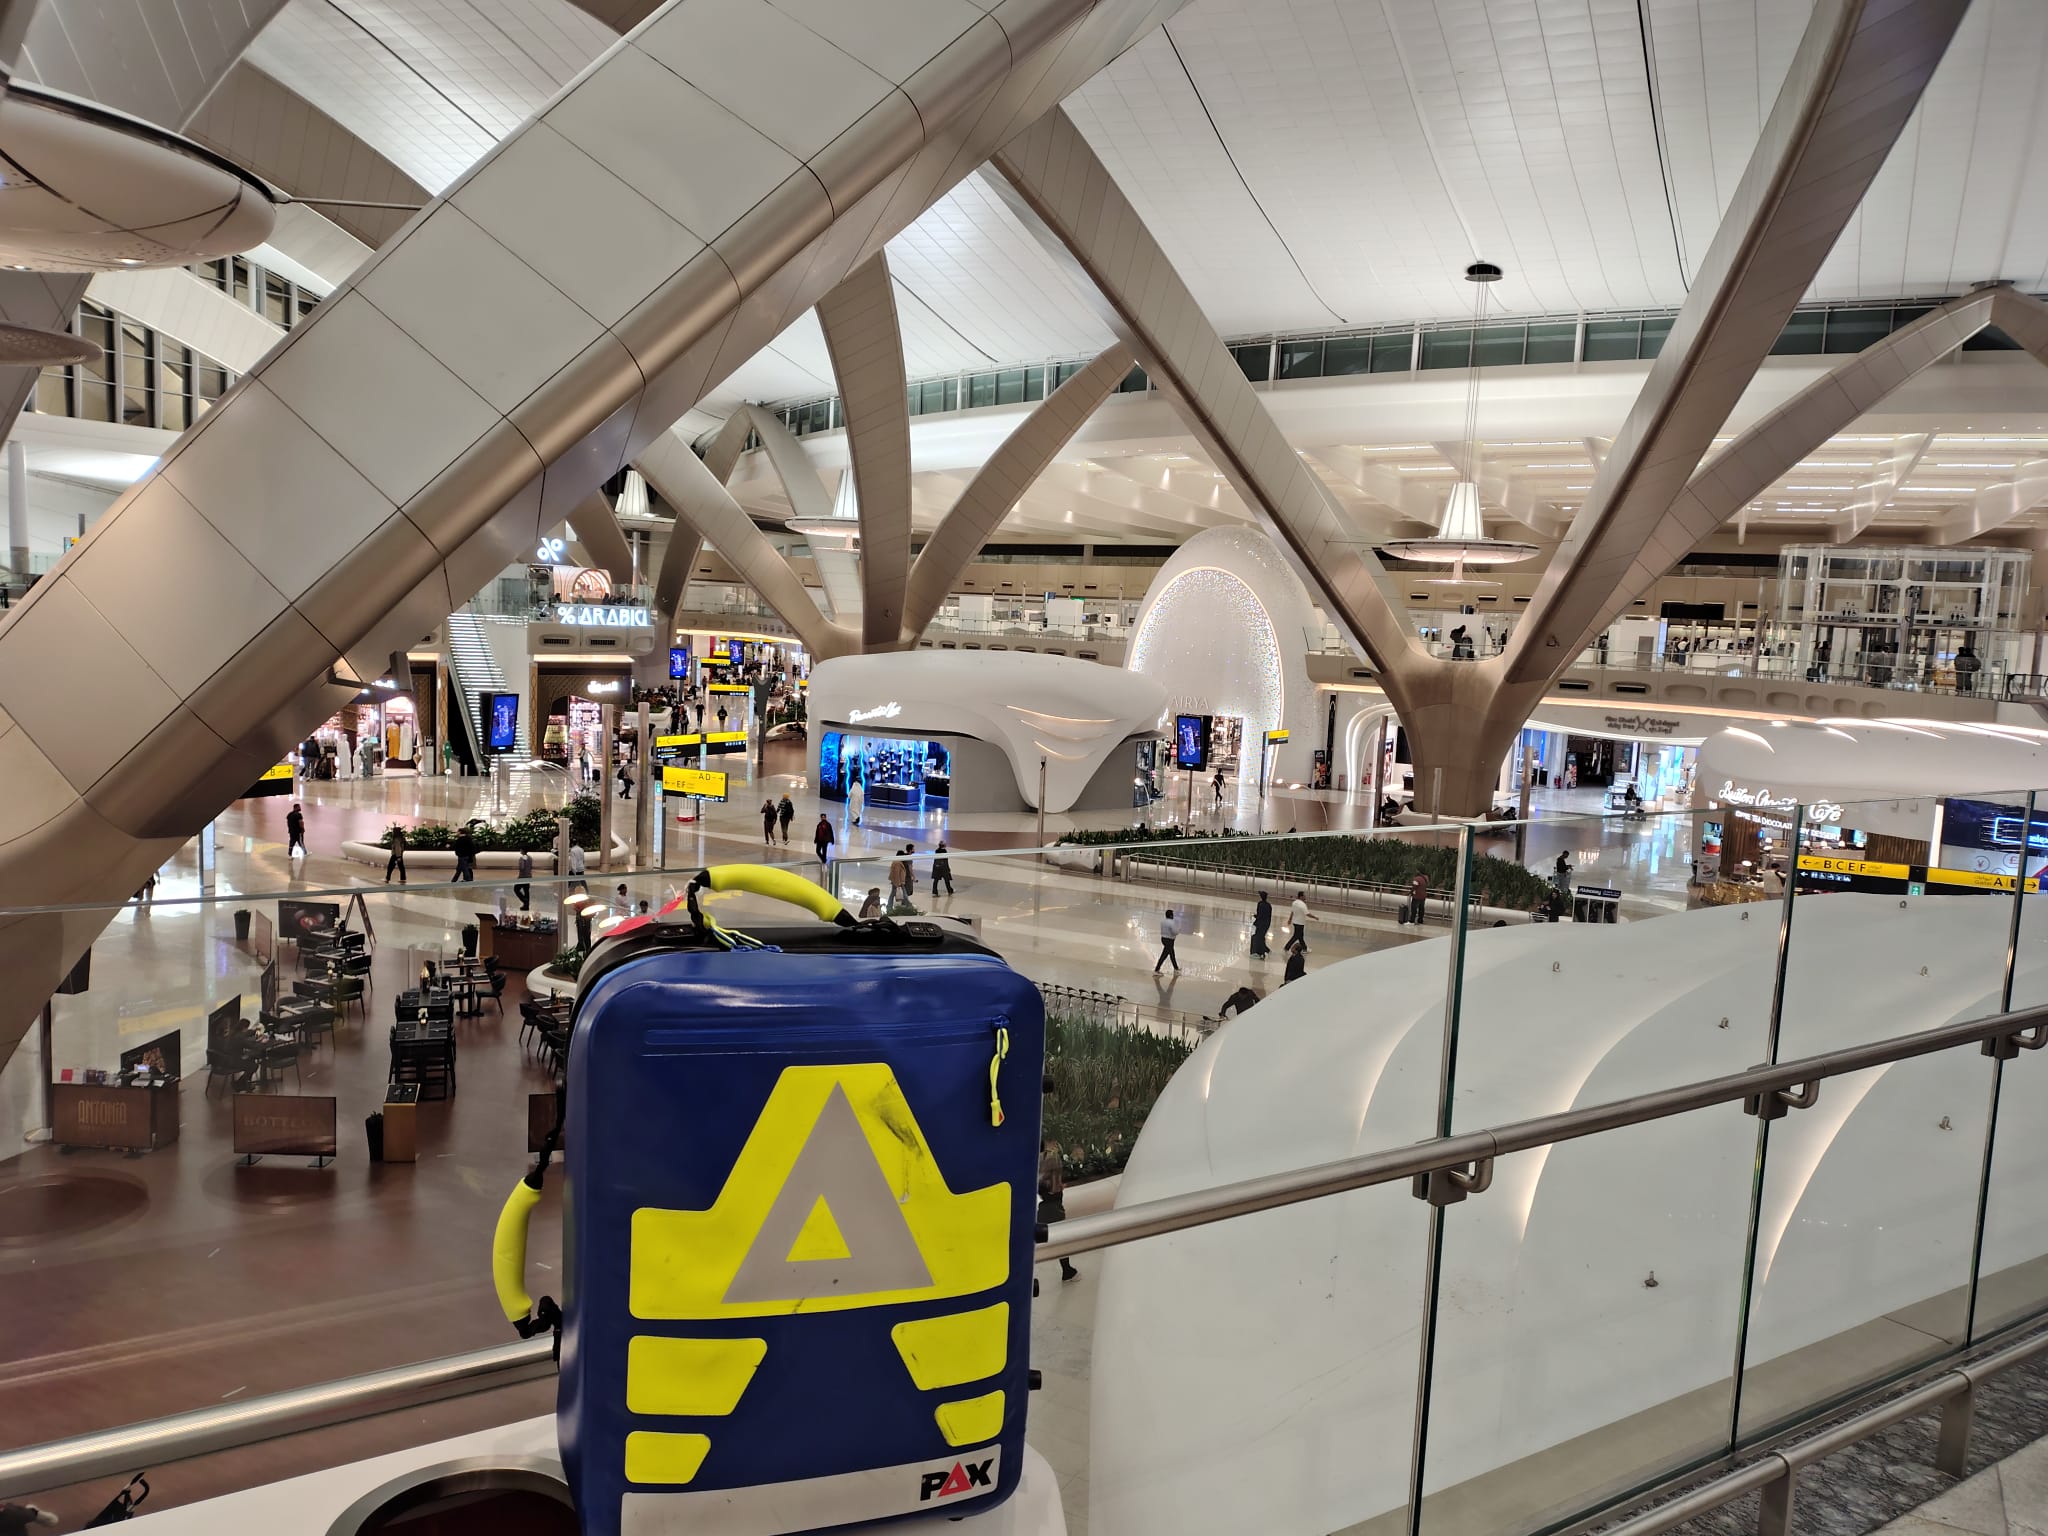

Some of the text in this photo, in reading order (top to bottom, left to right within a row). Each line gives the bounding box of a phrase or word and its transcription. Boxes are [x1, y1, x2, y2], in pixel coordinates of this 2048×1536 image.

[1823, 860, 1832, 868] B
[1836, 861, 1845, 870] C
[1848, 862, 1855, 871] E
[1860, 863, 1866, 872] F
[1994, 877, 2003, 887] A
[919, 1457, 995, 1502] PAX
